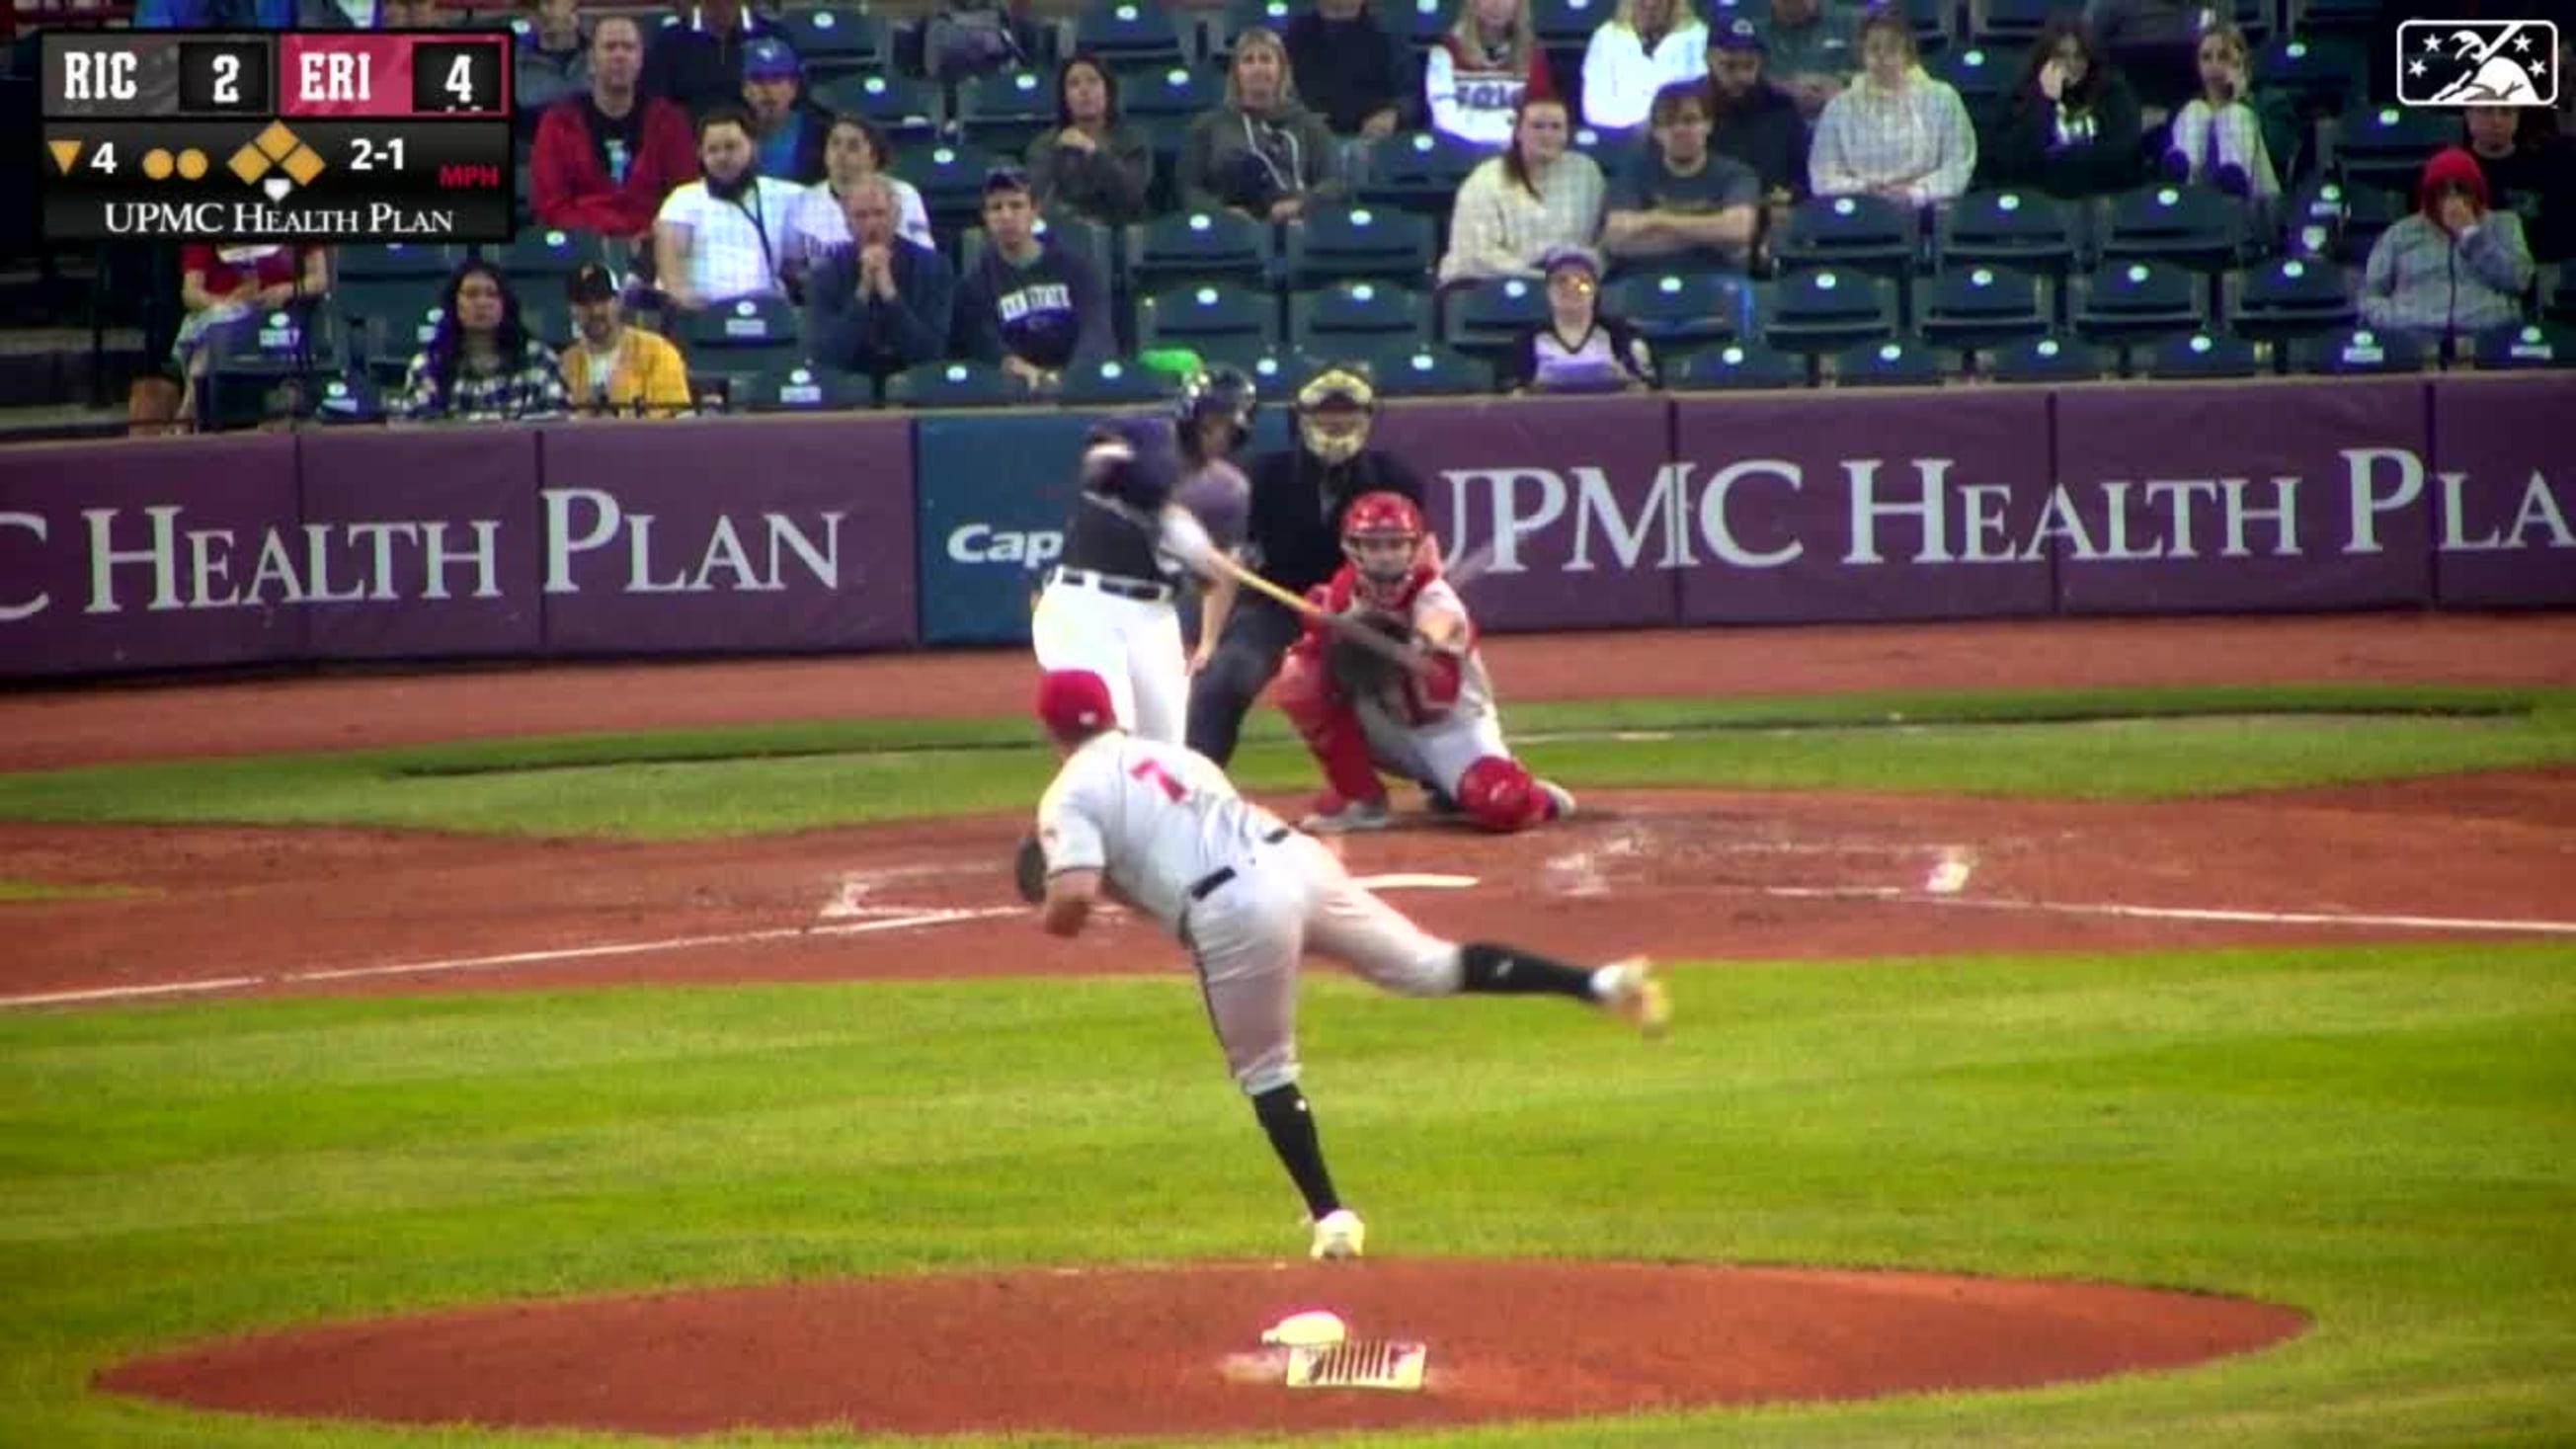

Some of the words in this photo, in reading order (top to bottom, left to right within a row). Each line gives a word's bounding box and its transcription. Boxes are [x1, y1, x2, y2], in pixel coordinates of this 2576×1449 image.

[83, 505, 502, 612] HEALTH
[541, 487, 844, 593] PLAN
[947, 523, 1064, 568] Cap
[1840, 458, 2302, 565] HEALTH
[1129, 758, 1186, 804] 7
